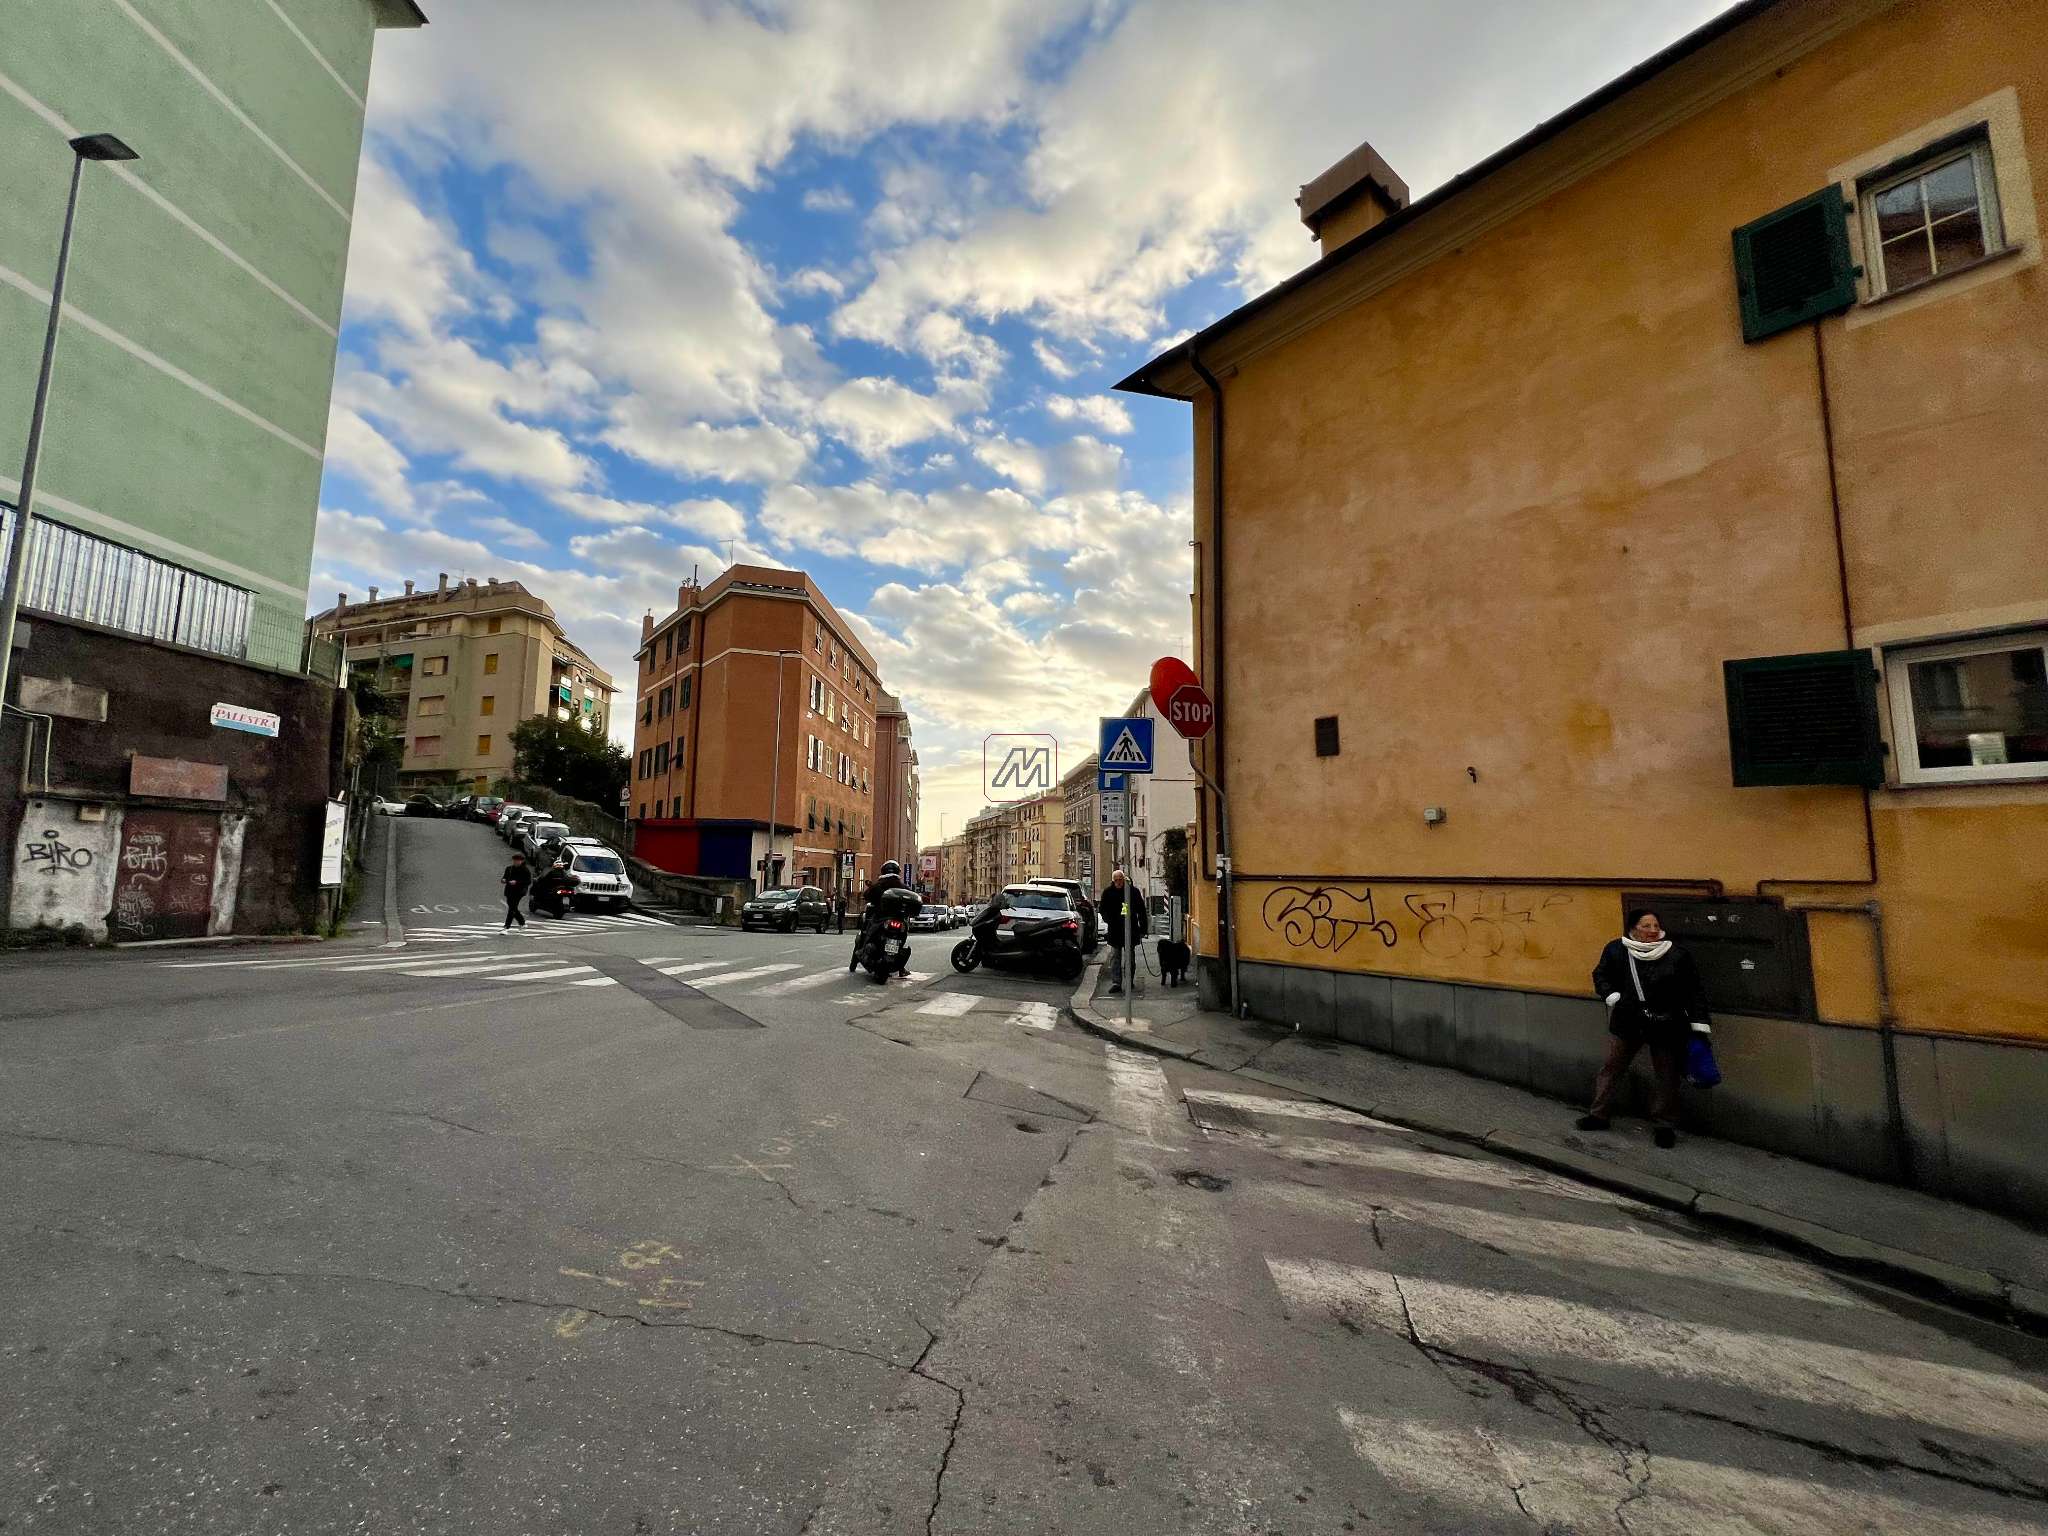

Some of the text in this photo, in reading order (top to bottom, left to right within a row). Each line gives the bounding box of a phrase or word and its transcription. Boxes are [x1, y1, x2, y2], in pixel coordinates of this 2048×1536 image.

[214, 708, 276, 729] PALESTRA
[1172, 700, 1211, 723] STOP
[22, 830, 92, 868] BIRO
